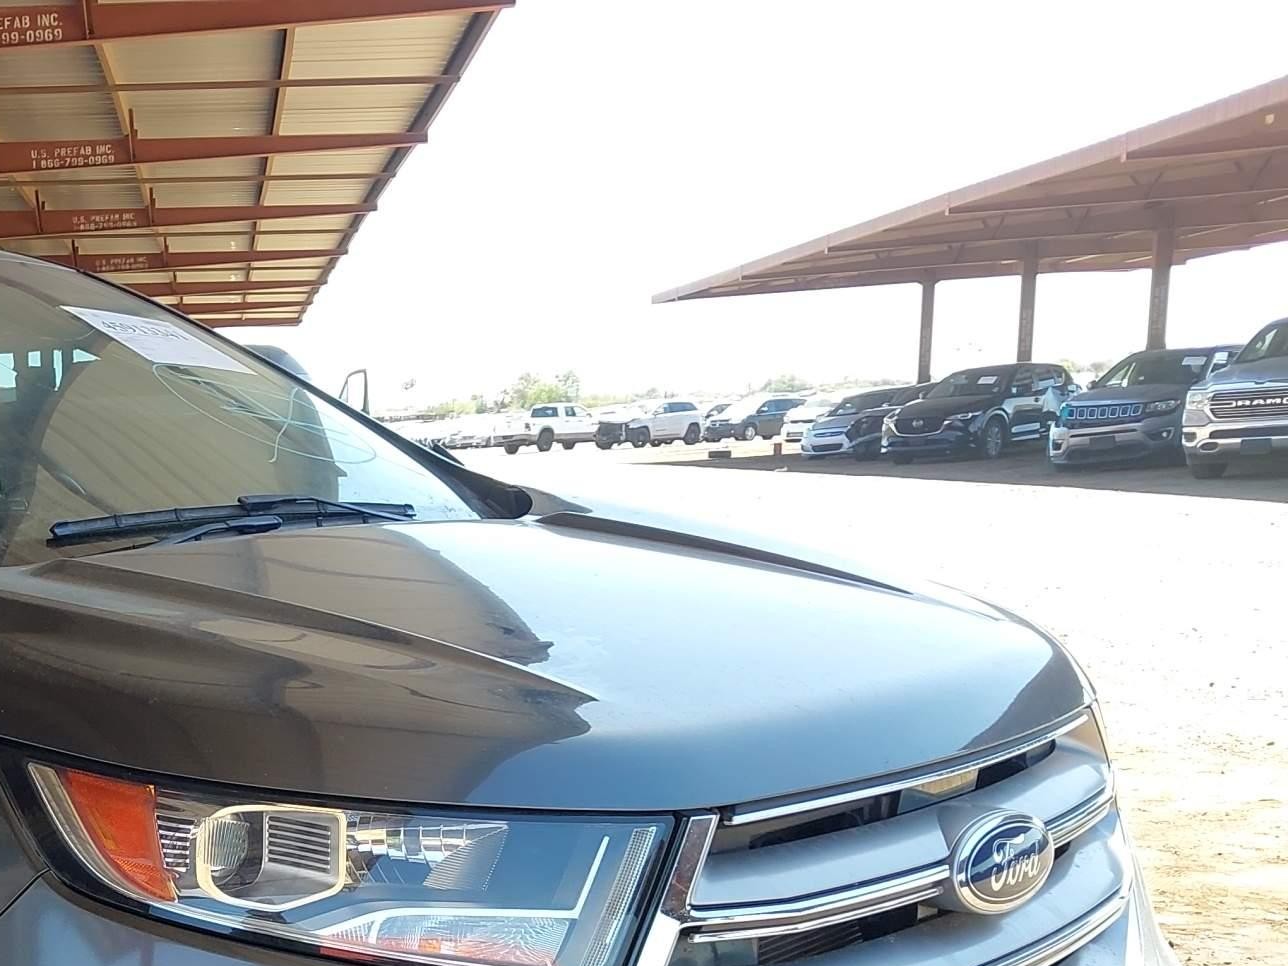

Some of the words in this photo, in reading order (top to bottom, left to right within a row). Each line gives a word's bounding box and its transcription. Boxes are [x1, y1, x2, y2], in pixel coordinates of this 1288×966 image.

[37, 13, 63, 27] INC.
[31, 149, 50, 159] U.S.
[54, 146, 92, 158] PREFAB
[96, 144, 115, 155] INC.
[990, 833, 1041, 892] Ford
